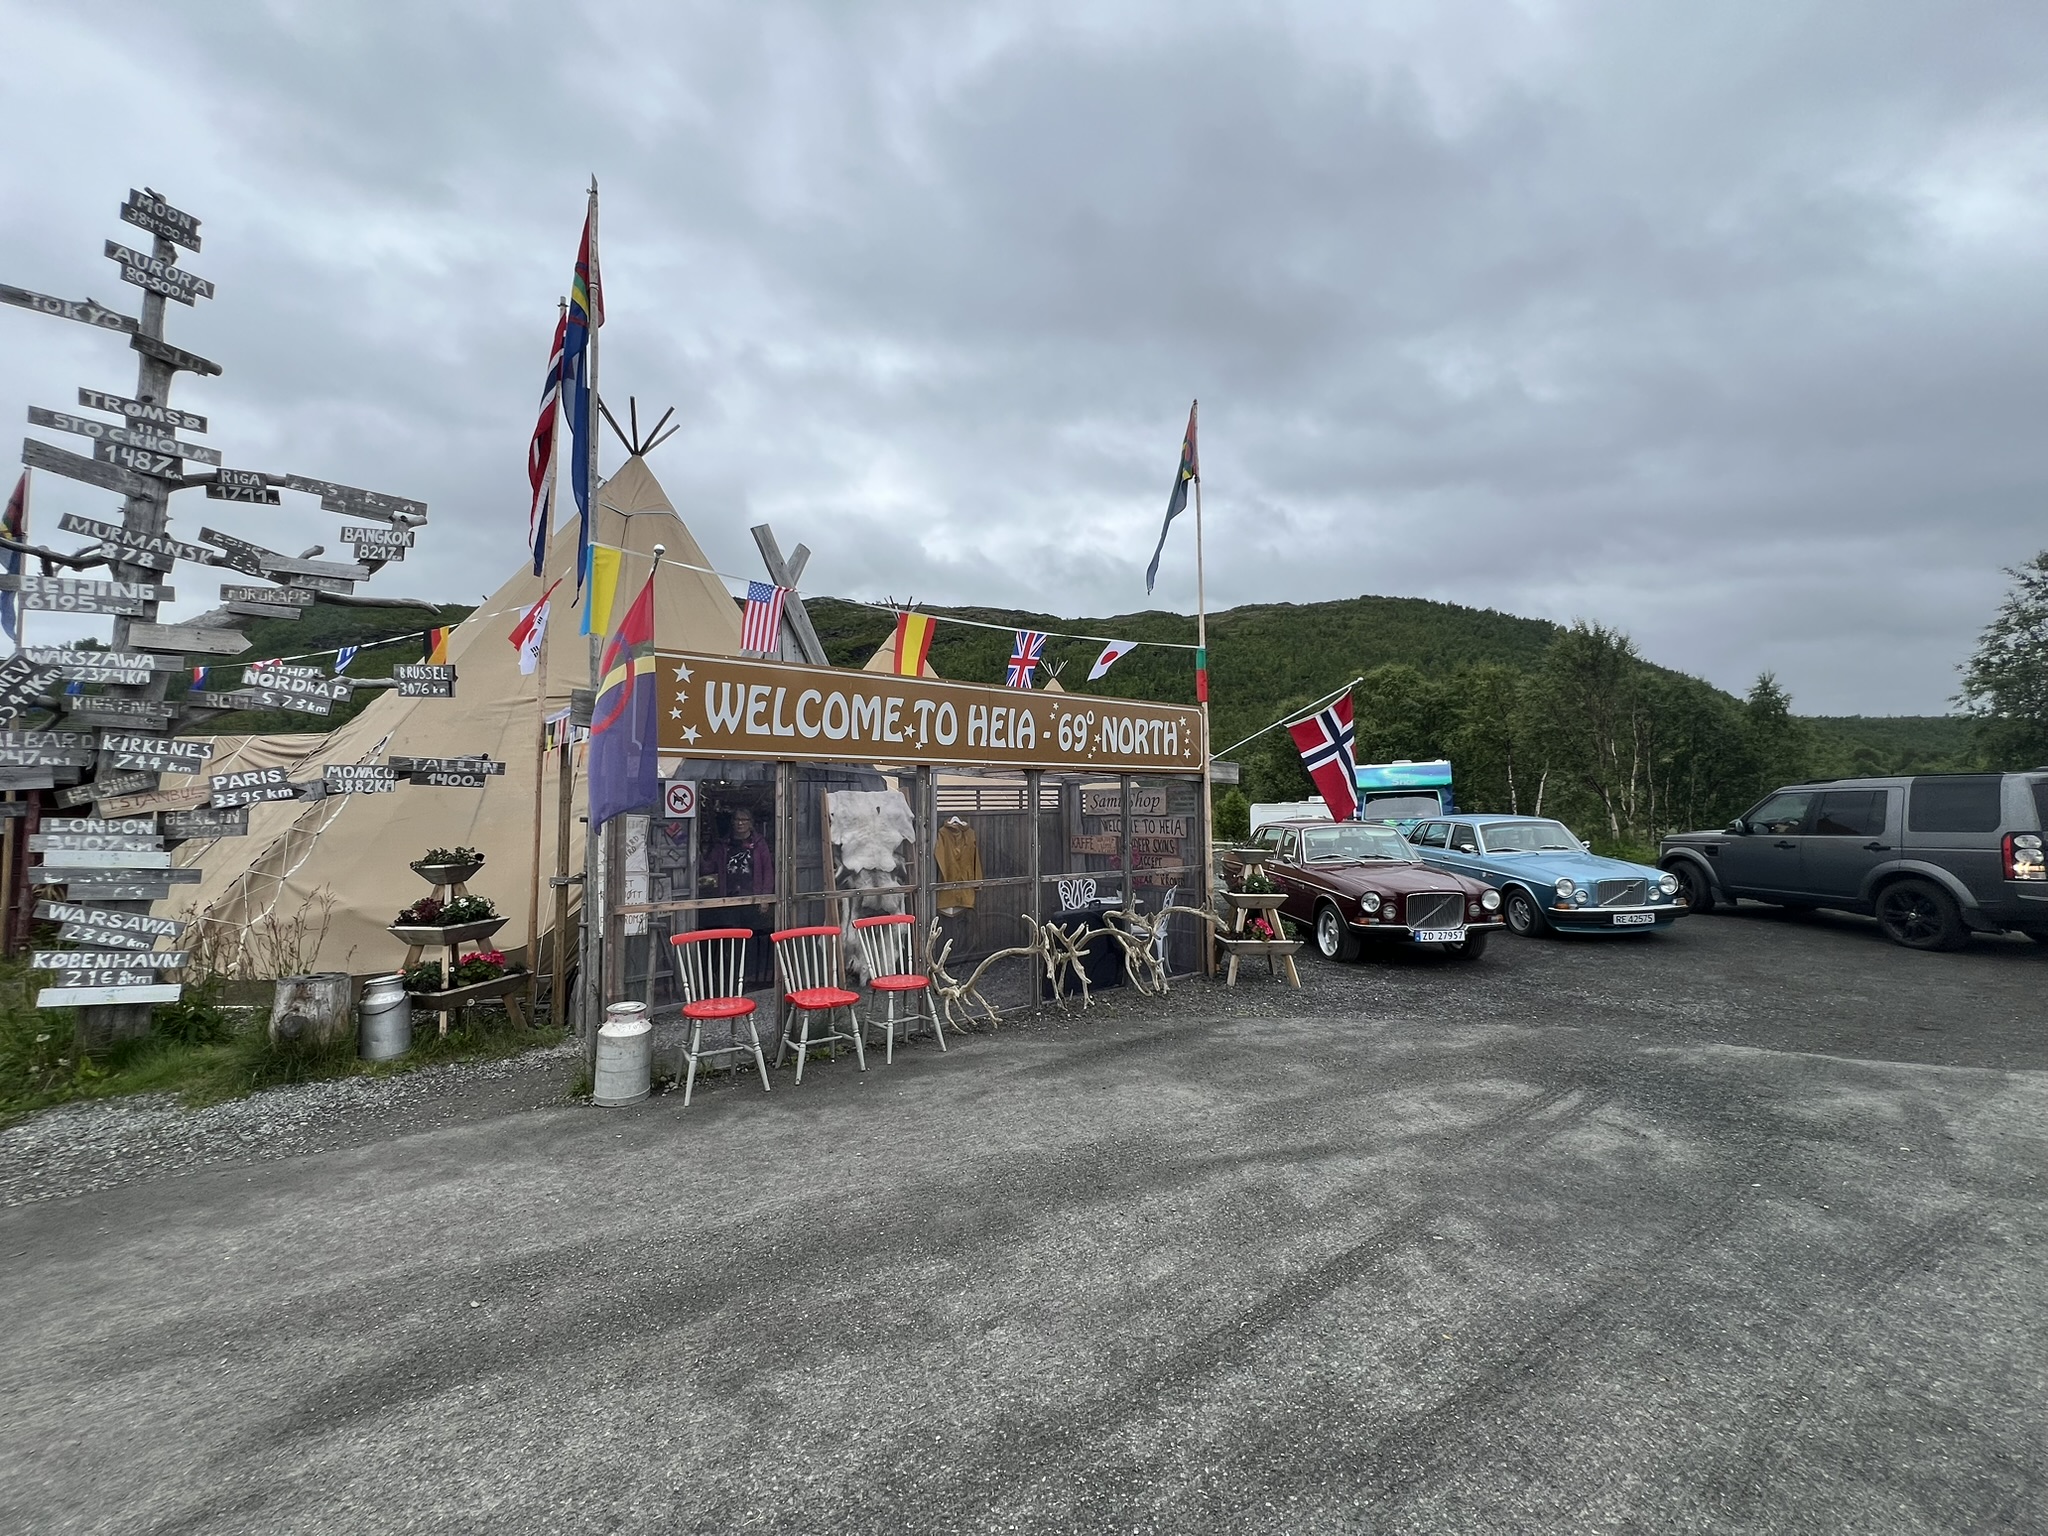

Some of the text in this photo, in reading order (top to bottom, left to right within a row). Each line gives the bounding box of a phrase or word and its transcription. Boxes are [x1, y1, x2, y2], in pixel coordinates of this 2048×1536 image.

[137, 195, 191, 229] MOON
[113, 246, 209, 296] AURORA
[126, 266, 180, 297] 80-500
[25, 292, 122, 329] TOKYO
[85, 391, 200, 429] TROMSØ
[54, 413, 211, 463] STOCKHOLM
[105, 445, 173, 473] 1487
[216, 485, 267, 502] 1711
[68, 516, 214, 566] MURMANSK
[344, 527, 411, 546] BANGKOK
[100, 542, 155, 569] 878
[359, 544, 397, 560] 8217
[20, 575, 154, 600] BEIJING
[25, 592, 97, 610] 6195
[25, 649, 156, 669] WARSZAWA
[400, 682, 430, 695] 3076
[307, 701, 326, 713] km
[705, 680, 905, 742] WELCOME
[913, 700, 957, 746] TO
[967, 704, 1036, 749] HEIA
[1042, 731, 1051, 739] -
[1102, 716, 1178, 756] NORTH
[102, 734, 212, 759] KIRKENES
[114, 754, 191, 773] 744 km
[212, 769, 282, 791] PARIS
[427, 773, 475, 787] 1400
[213, 786, 294, 808] 3395 km
[50, 818, 153, 834] LONDON
[1142, 819, 1155, 834] TO
[1160, 819, 1184, 836] HEIA
[47, 835, 123, 851] 3407
[49, 904, 176, 936] WARSAWA
[1616, 914, 1653, 923] RE 42575
[65, 925, 149, 949] 2380 km
[1422, 931, 1463, 940] ZD 27957
[32, 952, 181, 968] KØBENHAVN
